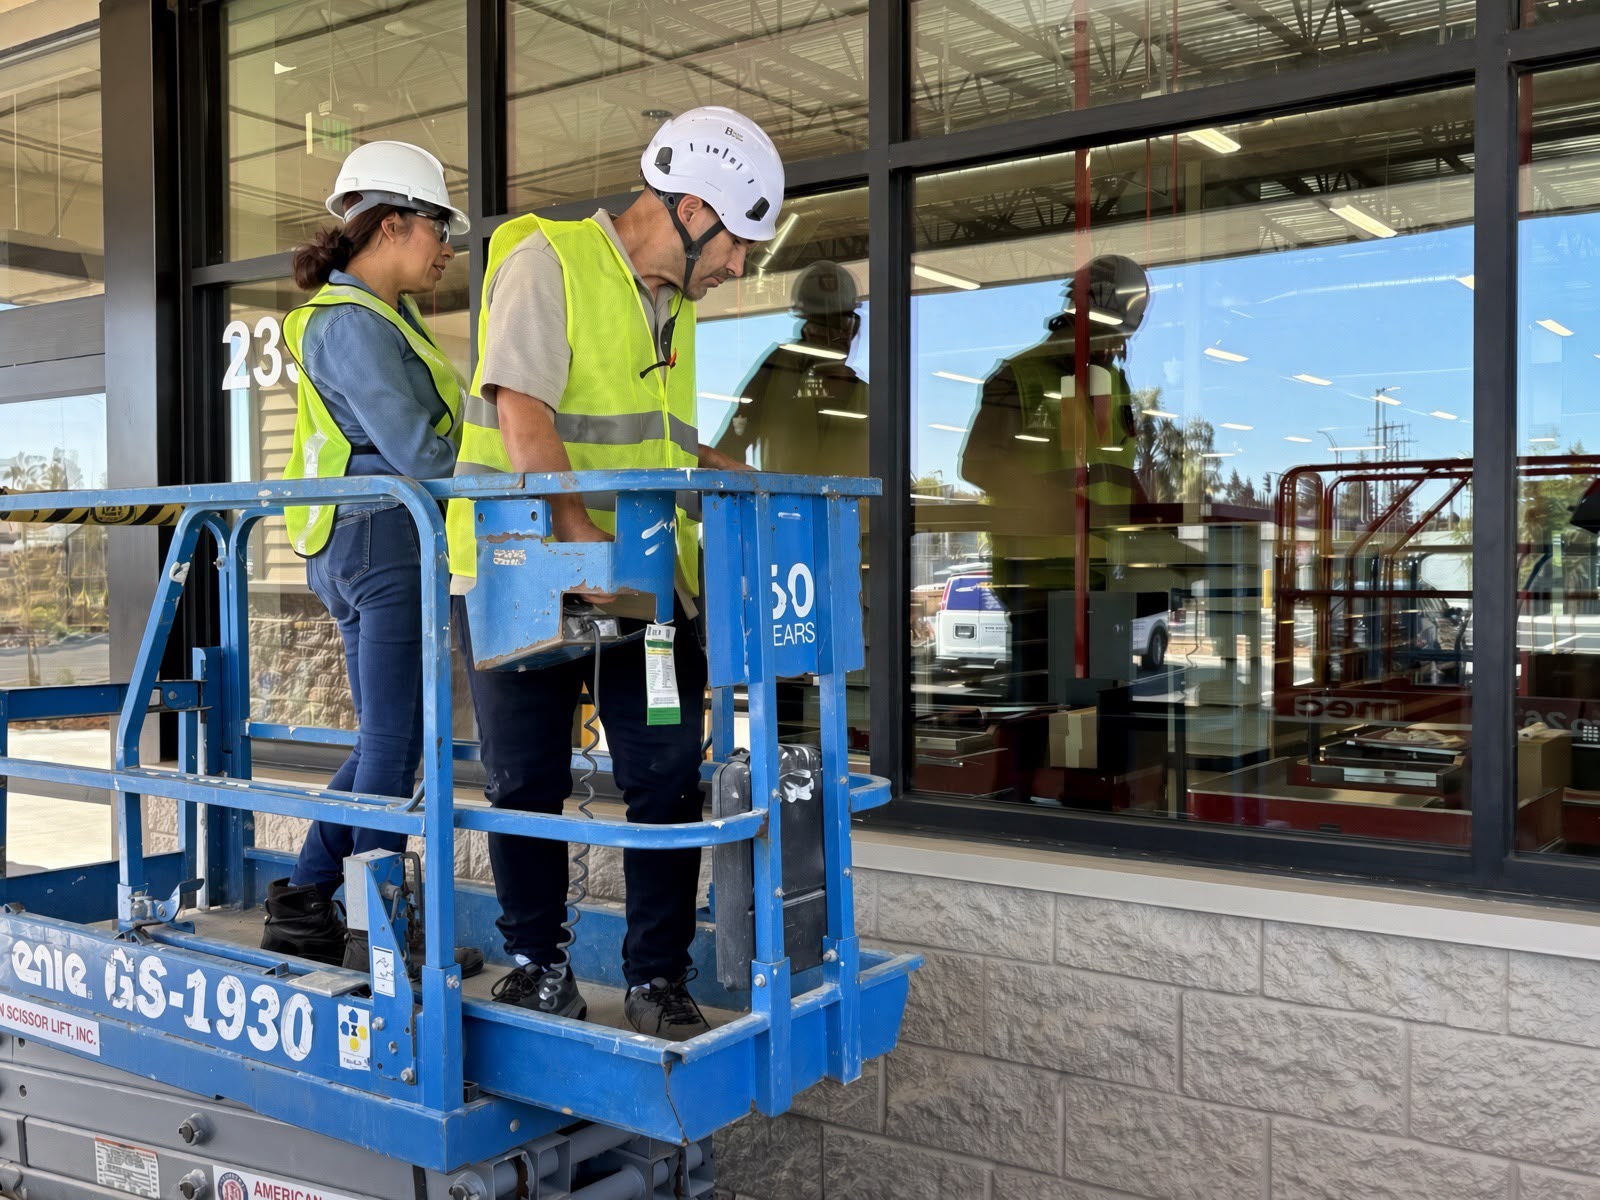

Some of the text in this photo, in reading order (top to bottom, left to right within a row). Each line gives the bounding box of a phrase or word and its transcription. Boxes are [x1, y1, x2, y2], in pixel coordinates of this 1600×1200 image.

[6, 1004, 49, 1031] SCISSOR
[51, 1017, 75, 1041] LIFT,
[76, 1025, 97, 1046] INC.
[104, 947, 314, 1061] GS-1930
